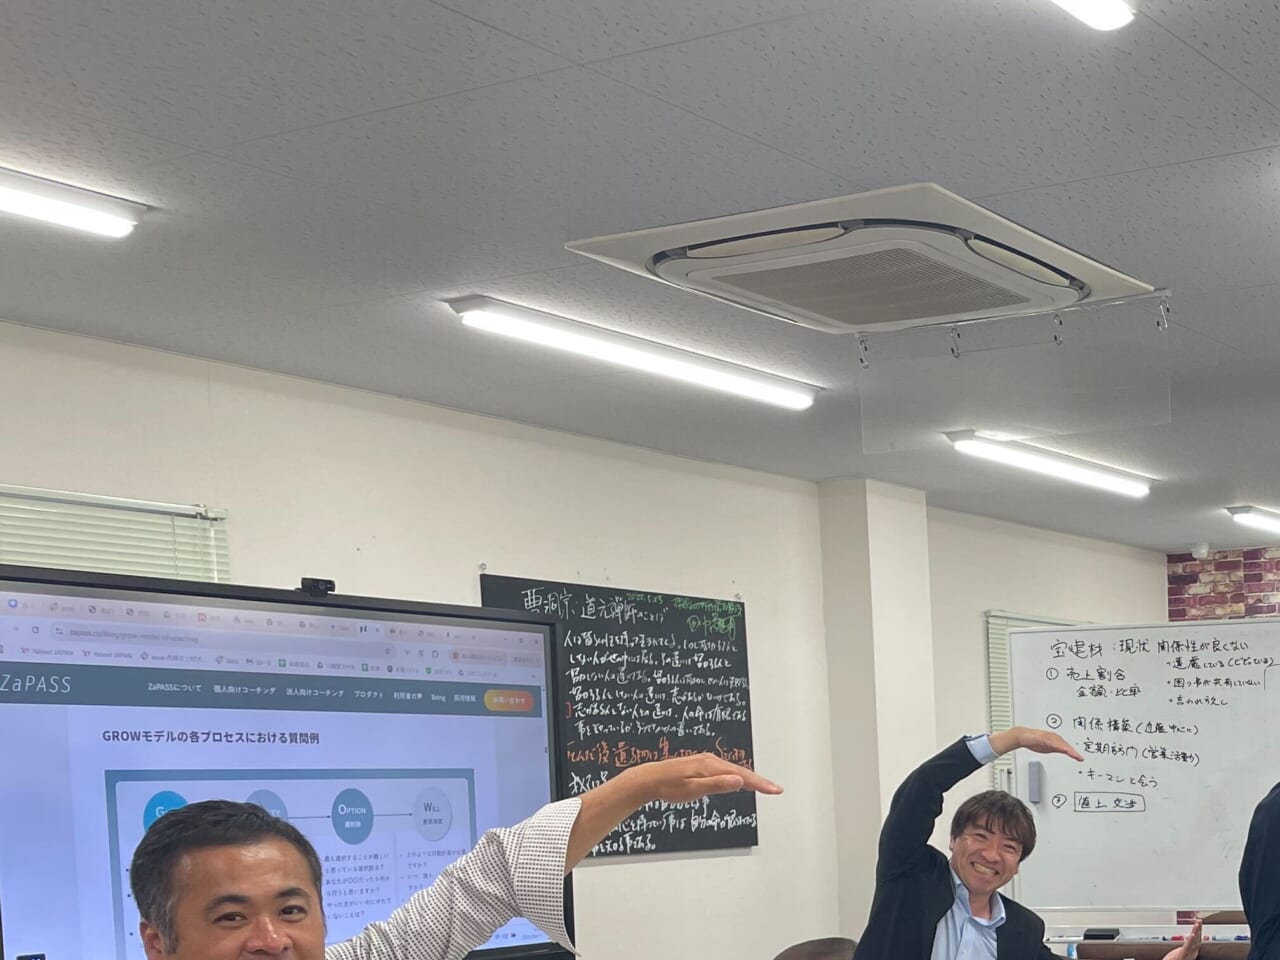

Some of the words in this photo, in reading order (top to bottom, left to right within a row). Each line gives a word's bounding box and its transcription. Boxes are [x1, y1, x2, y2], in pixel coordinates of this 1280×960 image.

[0, 674, 71, 693] ZaPASS
[148, 683, 202, 692] ZaPASSについて
[102, 730, 320, 745] GROWモデルの各プロセスにおける質問例
